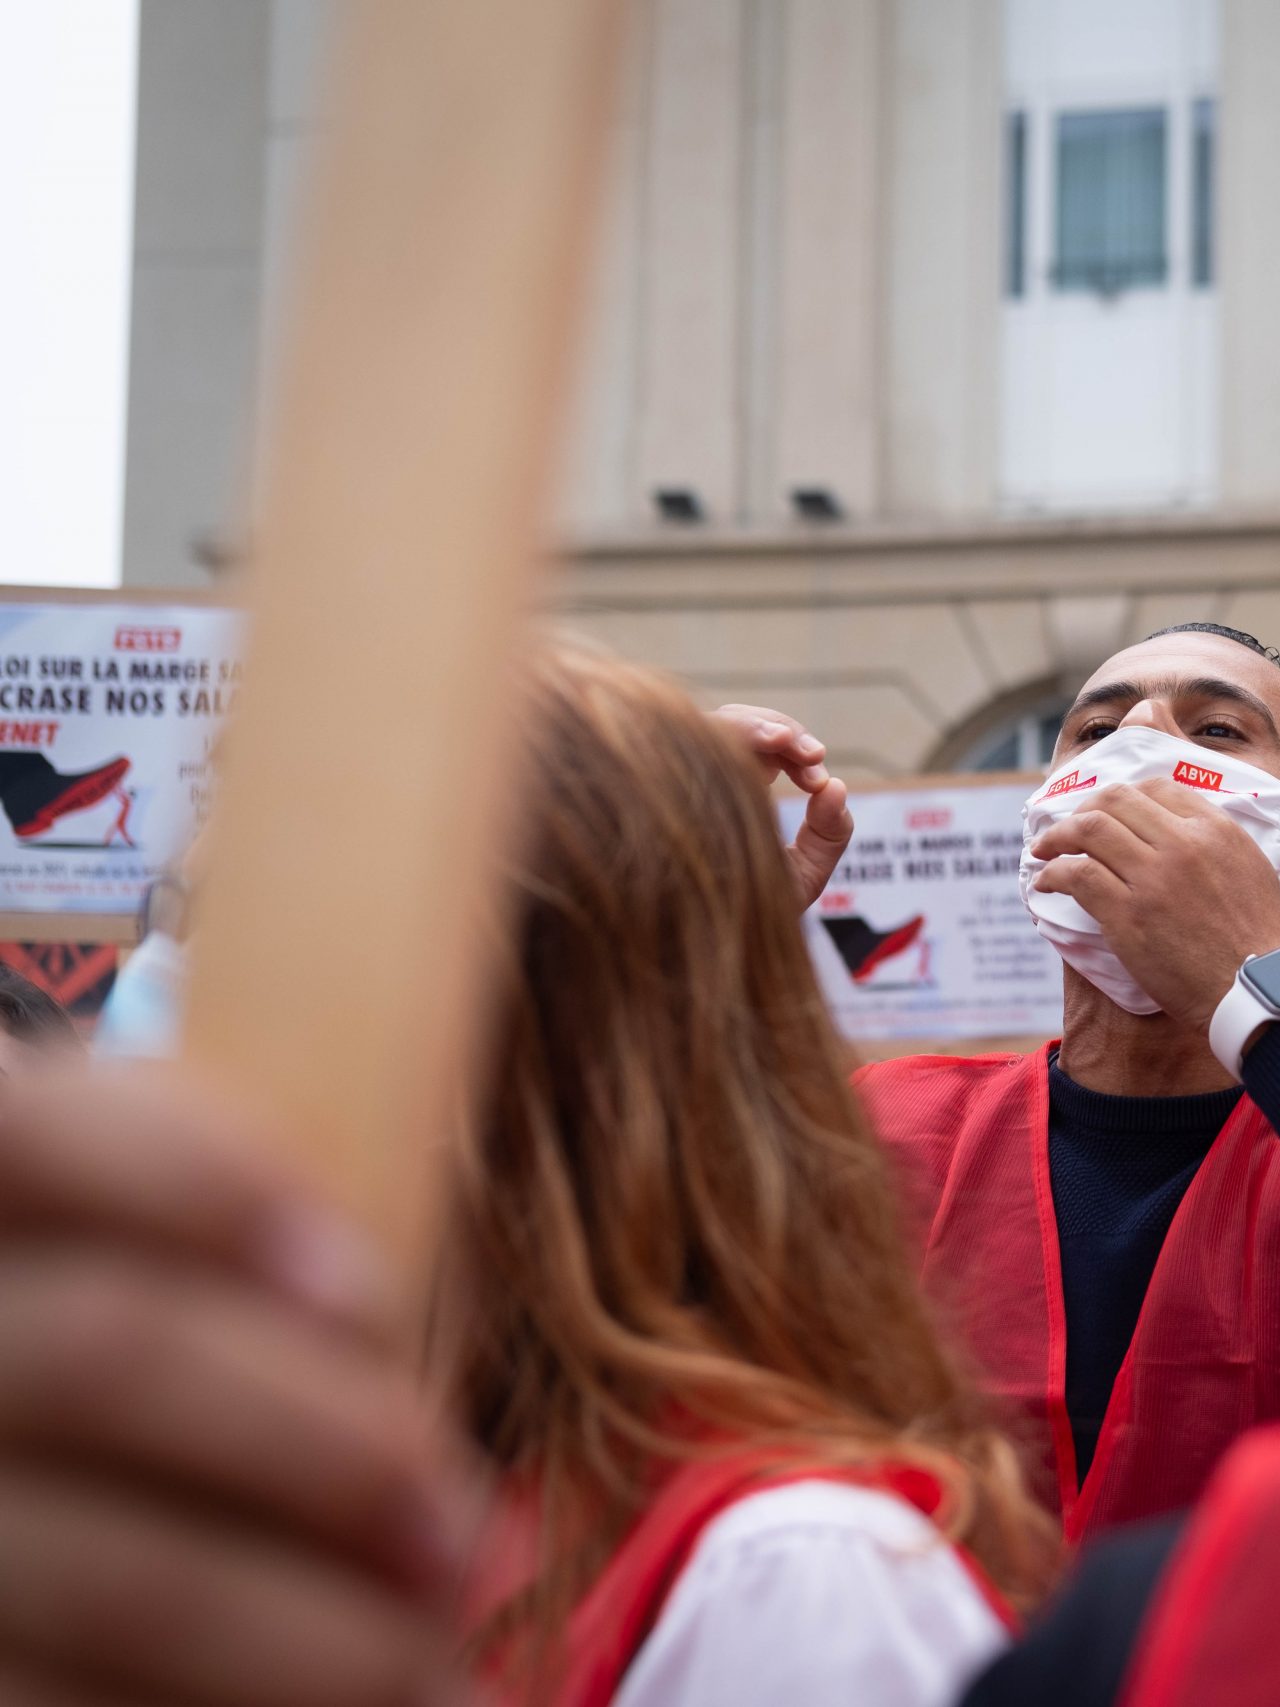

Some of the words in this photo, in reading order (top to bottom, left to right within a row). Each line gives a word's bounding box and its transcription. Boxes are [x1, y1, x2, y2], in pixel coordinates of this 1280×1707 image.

[0, 656, 28, 679] OI
[39, 657, 83, 680] SUR
[93, 658, 119, 680] LA
[129, 660, 209, 681] MARGE
[106, 687, 164, 716] NOS
[1049, 774, 1076, 793] FGTB
[1177, 764, 1218, 786] ABVV
